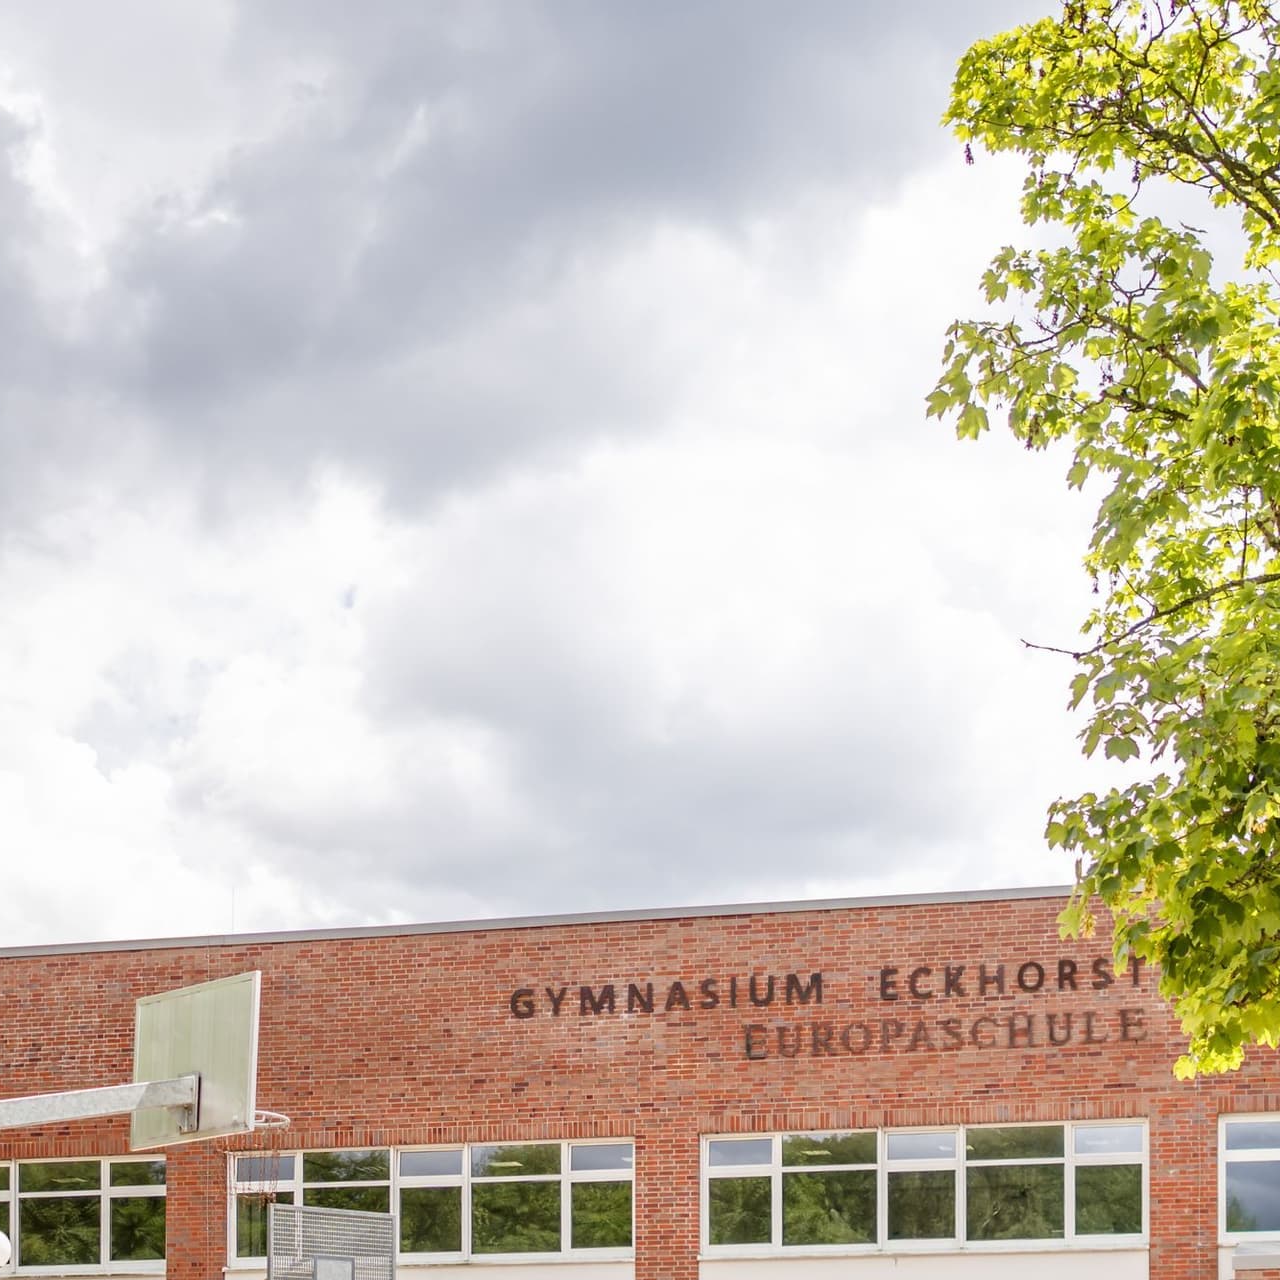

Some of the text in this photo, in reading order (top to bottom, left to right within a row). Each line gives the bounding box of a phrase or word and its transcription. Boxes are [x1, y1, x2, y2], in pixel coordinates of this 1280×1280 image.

[510, 954, 1147, 1019] GYMNASIUM ECKHORST
[743, 1007, 1148, 1060] EUROPASCHULE
